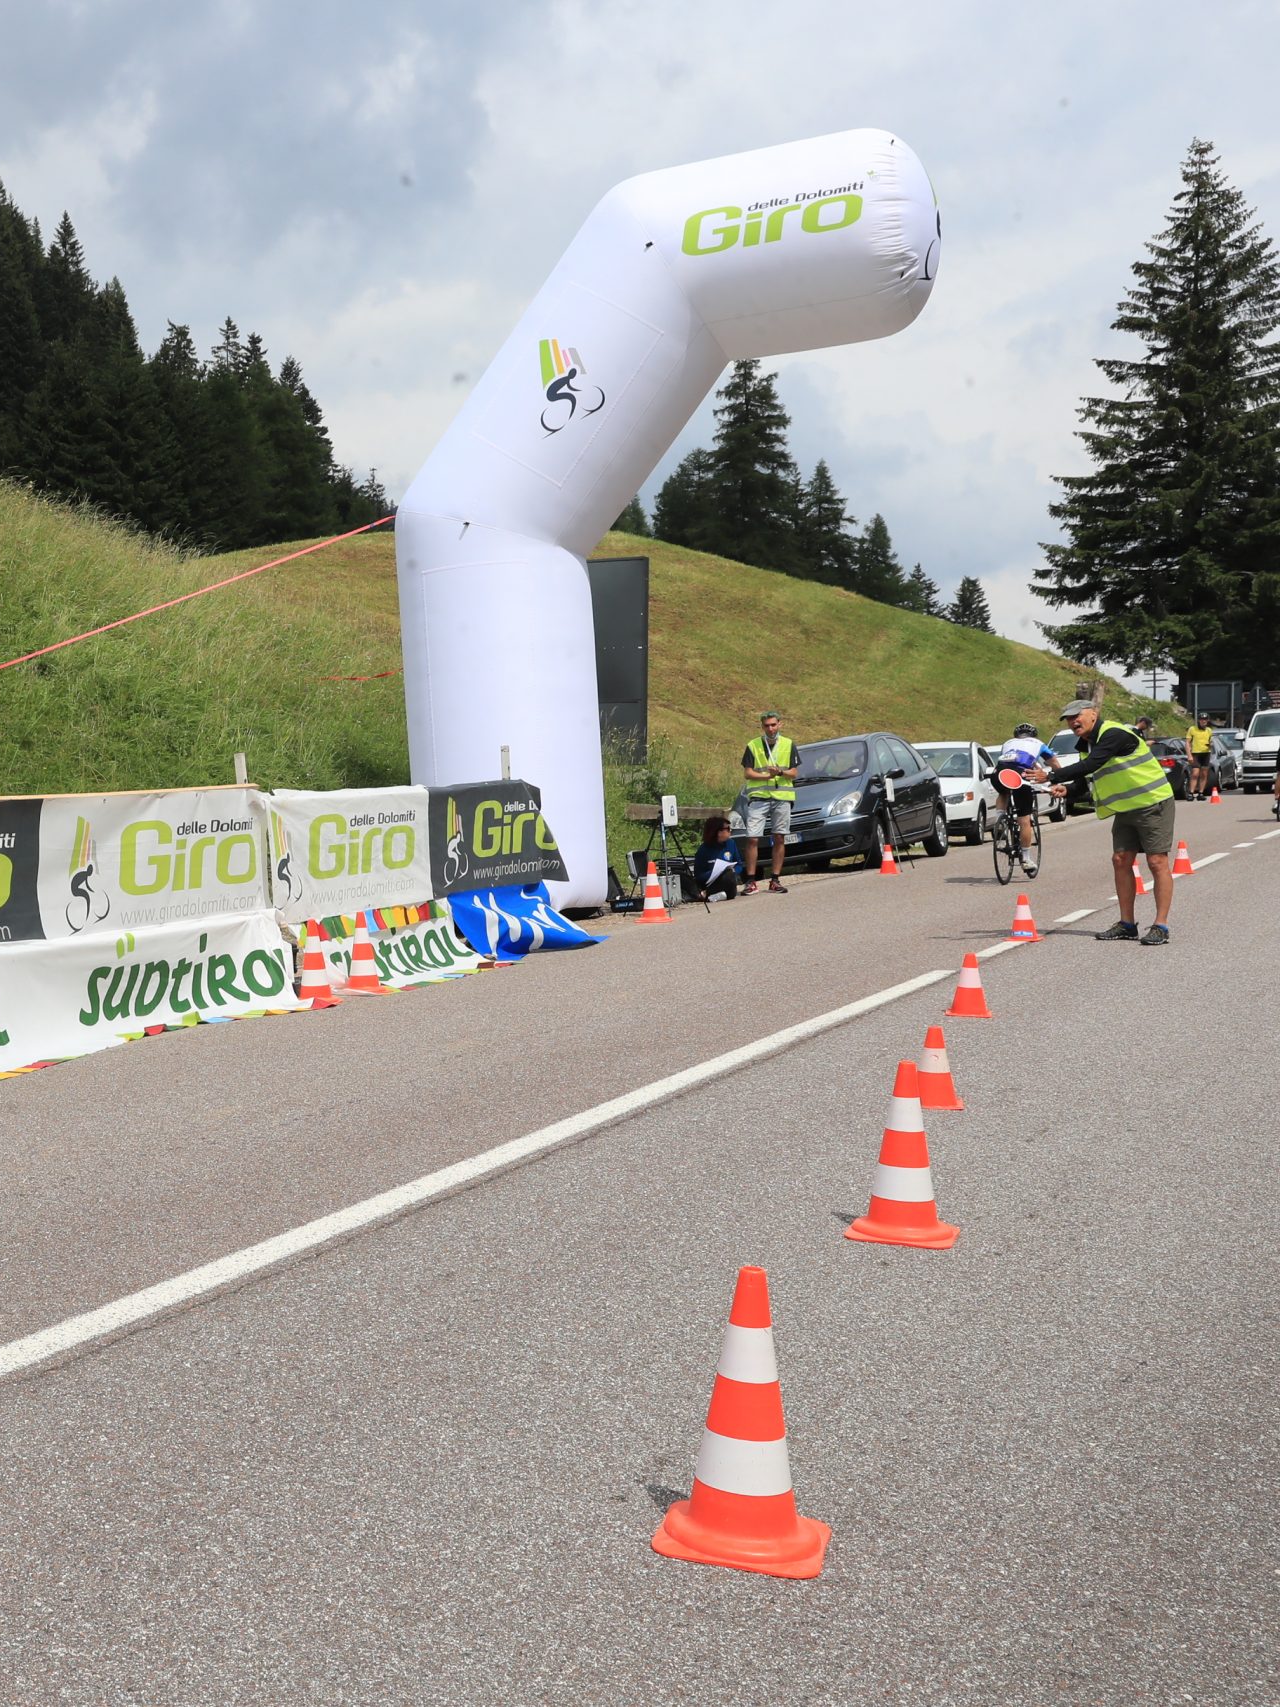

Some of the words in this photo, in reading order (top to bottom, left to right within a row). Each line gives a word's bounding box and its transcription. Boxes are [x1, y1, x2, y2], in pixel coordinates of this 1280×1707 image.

[747, 196, 789, 212] delle
[795, 181, 864, 203] Dolomiti
[681, 194, 864, 256] Giro
[350, 815, 375, 827] delle
[377, 810, 416, 824] Dolomiti
[504, 801, 526, 812] delle
[176, 821, 207, 836] delle
[119, 820, 257, 896] Giro
[308, 813, 415, 880] Giro
[310, 878, 415, 905] www.girodolomiti.com
